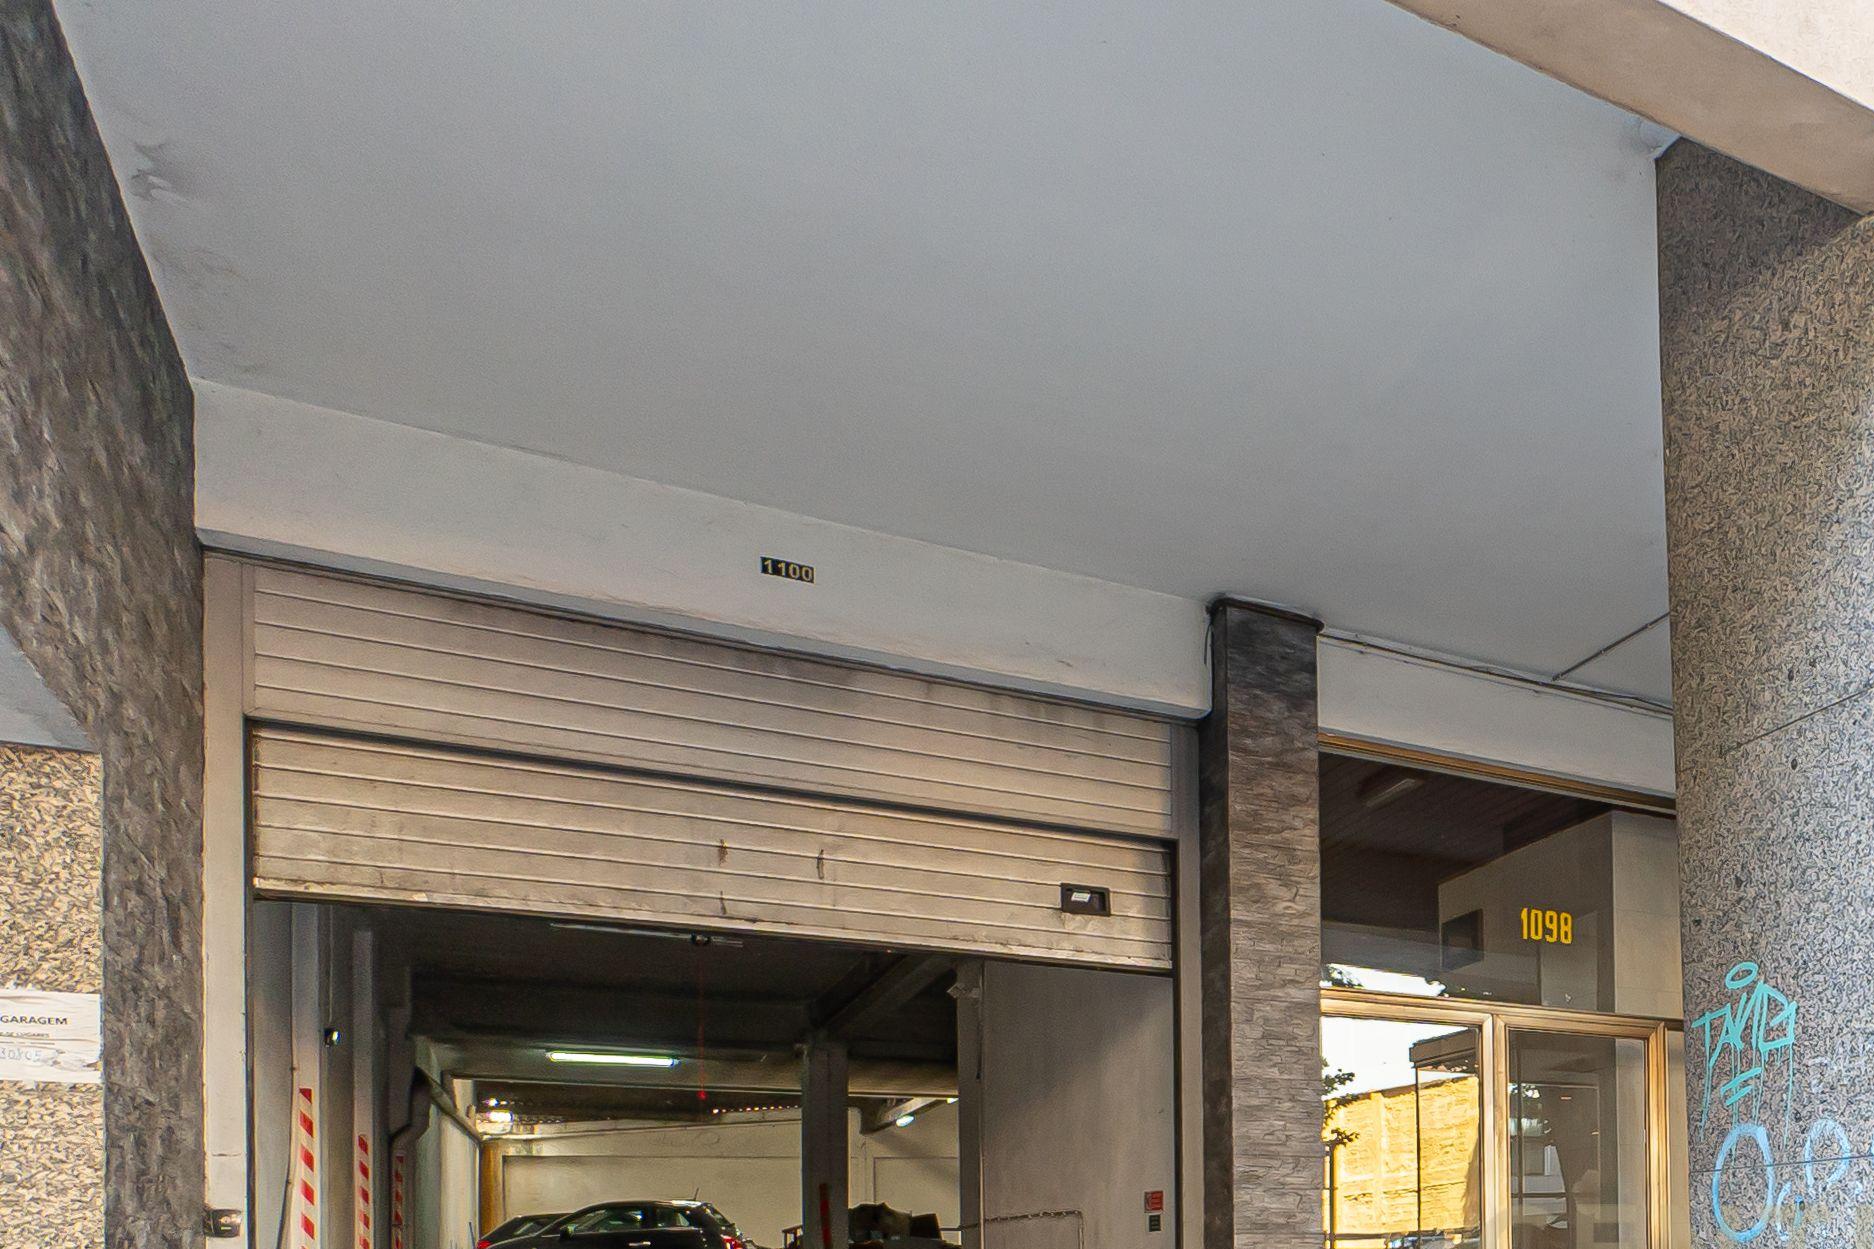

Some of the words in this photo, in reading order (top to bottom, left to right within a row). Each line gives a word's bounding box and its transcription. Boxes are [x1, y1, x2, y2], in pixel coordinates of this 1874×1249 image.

[764, 559, 813, 581] 1100
[1521, 907, 1572, 944] 1098
[0, 1014, 68, 1026] GARAGEM
